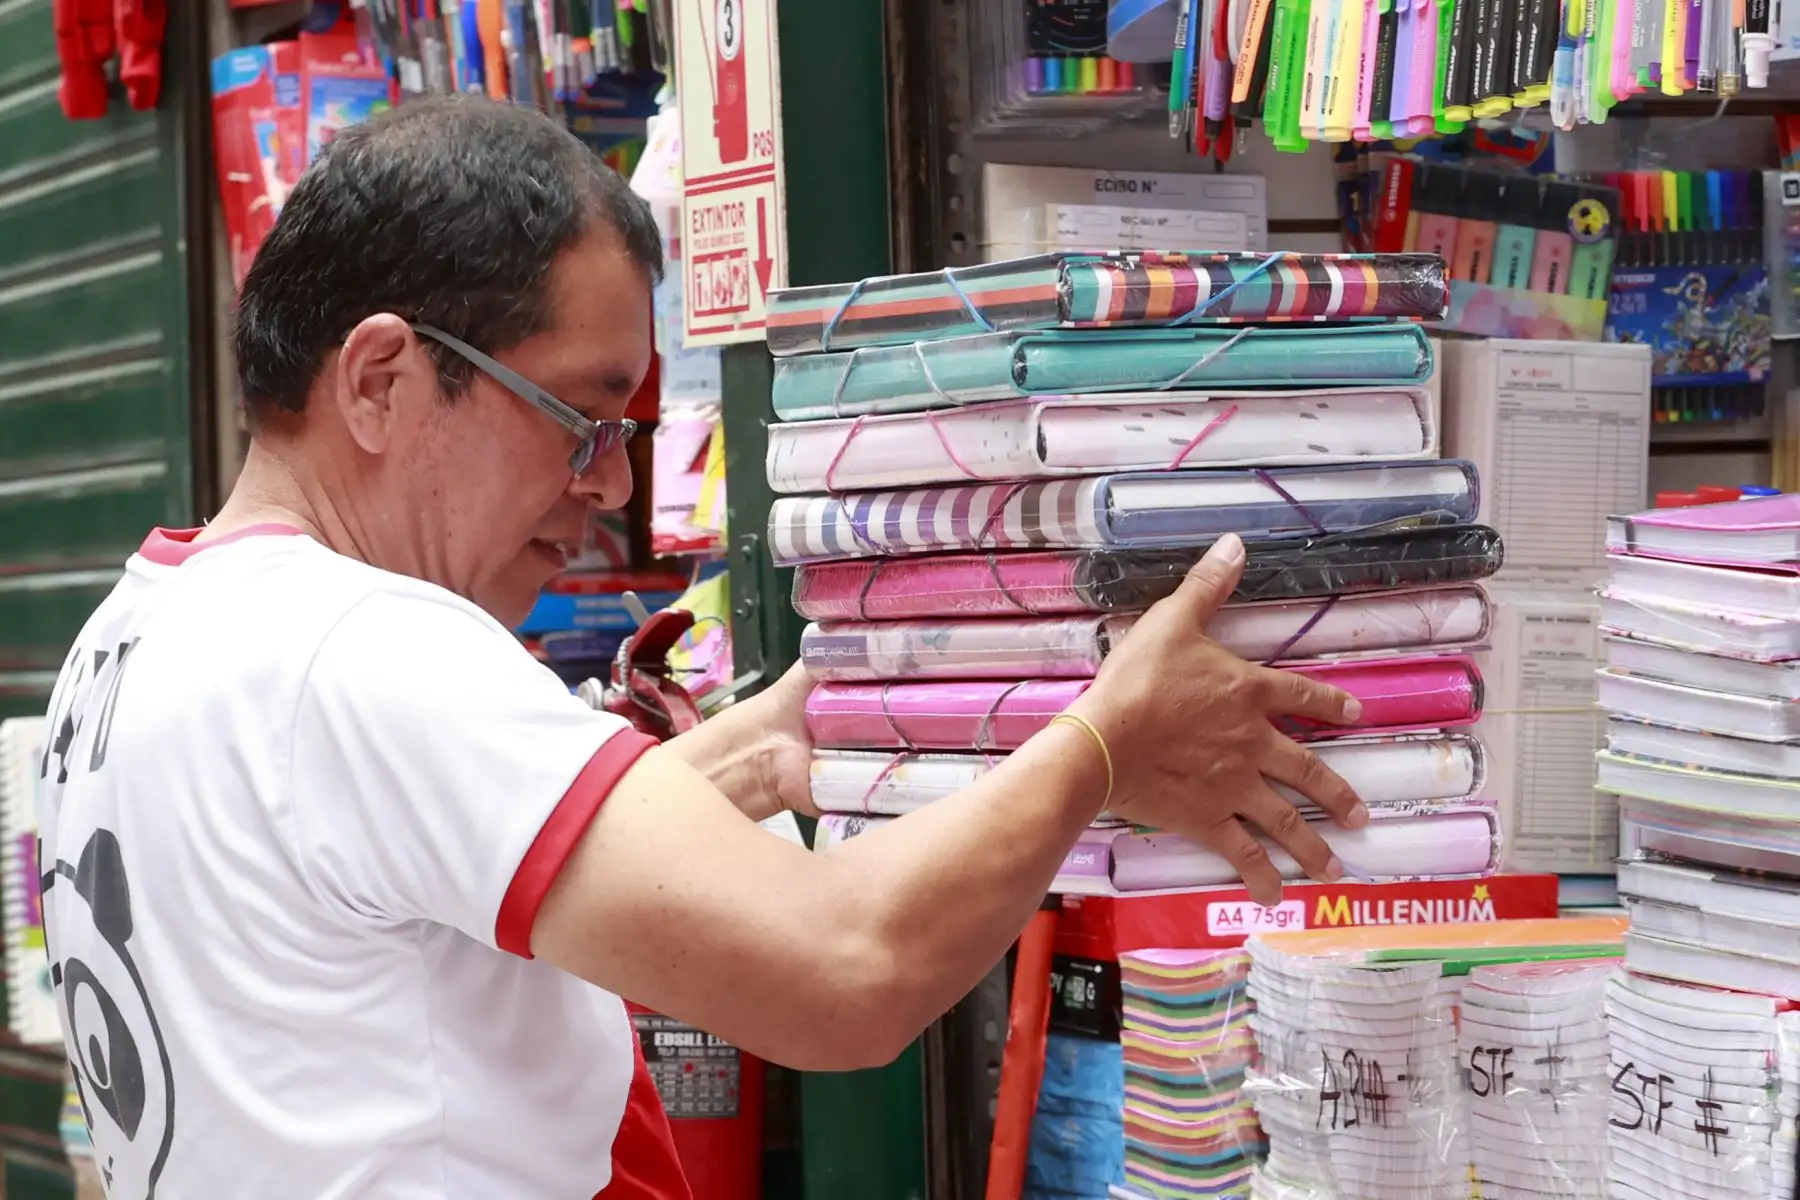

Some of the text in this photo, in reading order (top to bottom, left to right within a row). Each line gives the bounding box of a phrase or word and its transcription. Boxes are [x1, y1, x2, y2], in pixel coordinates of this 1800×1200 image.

[1446, 45, 1457, 100] ARTESCO
[1473, 43, 1483, 98] ARTESCO
[1485, 37, 1496, 92] ARTESCO
[1513, 30, 1522, 87] ARTESCO
[1526, 23, 1538, 79] ARTESCO
[1094, 178, 1138, 193] ECIBO
[693, 201, 746, 234] EXTINTOR
[1216, 895, 1497, 928] A4 75gr. MILLENIUM
[1470, 1045, 1514, 1098] STF
[1608, 1061, 1675, 1136] STF
